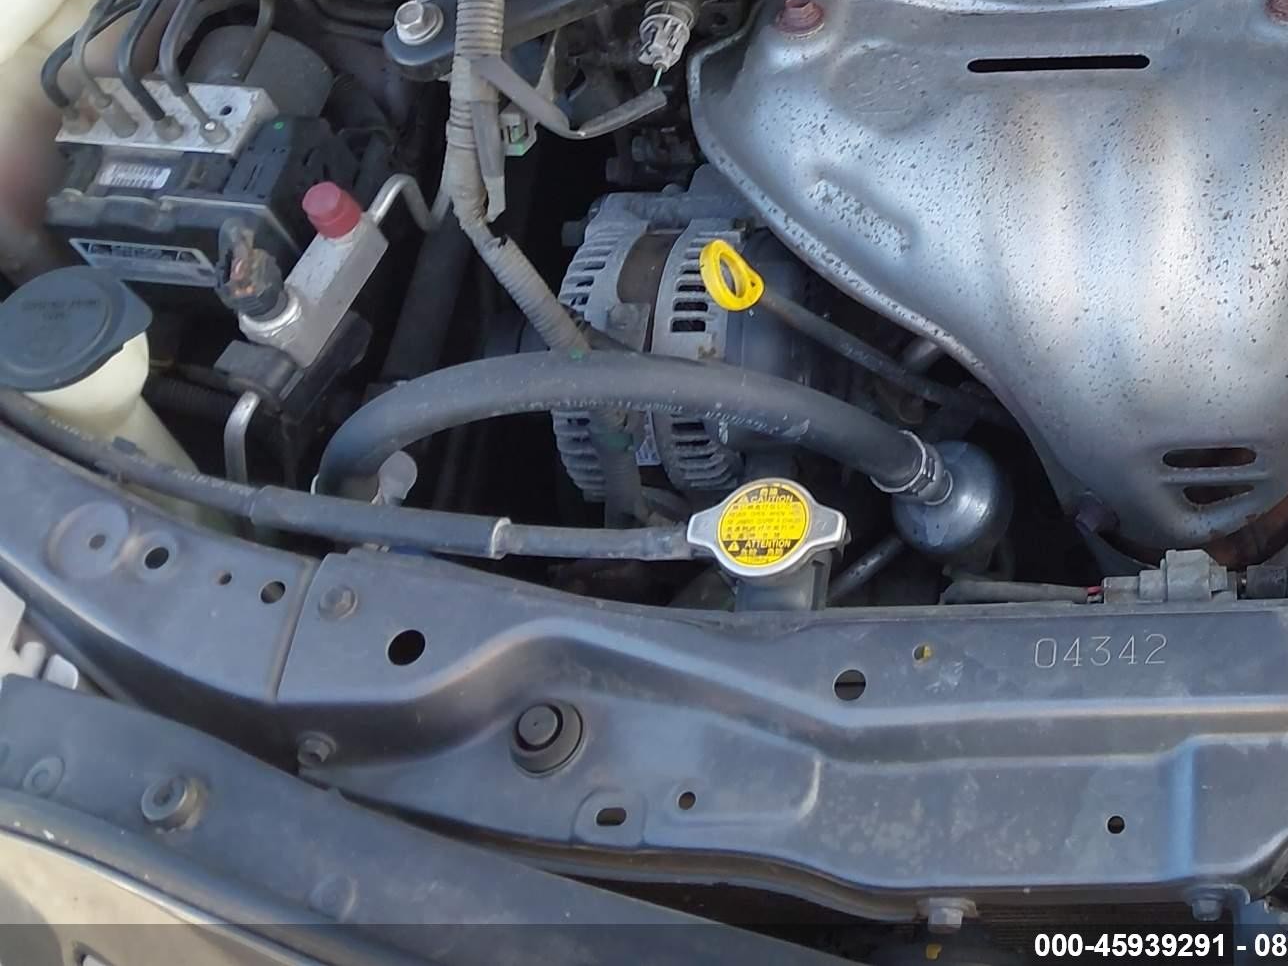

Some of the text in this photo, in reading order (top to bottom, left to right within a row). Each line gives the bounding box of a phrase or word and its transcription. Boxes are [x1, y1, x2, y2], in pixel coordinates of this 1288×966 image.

[750, 494, 793, 503] CAUTION
[744, 539, 791, 549] ATTENTION
[1034, 632, 1168, 668] 04342
